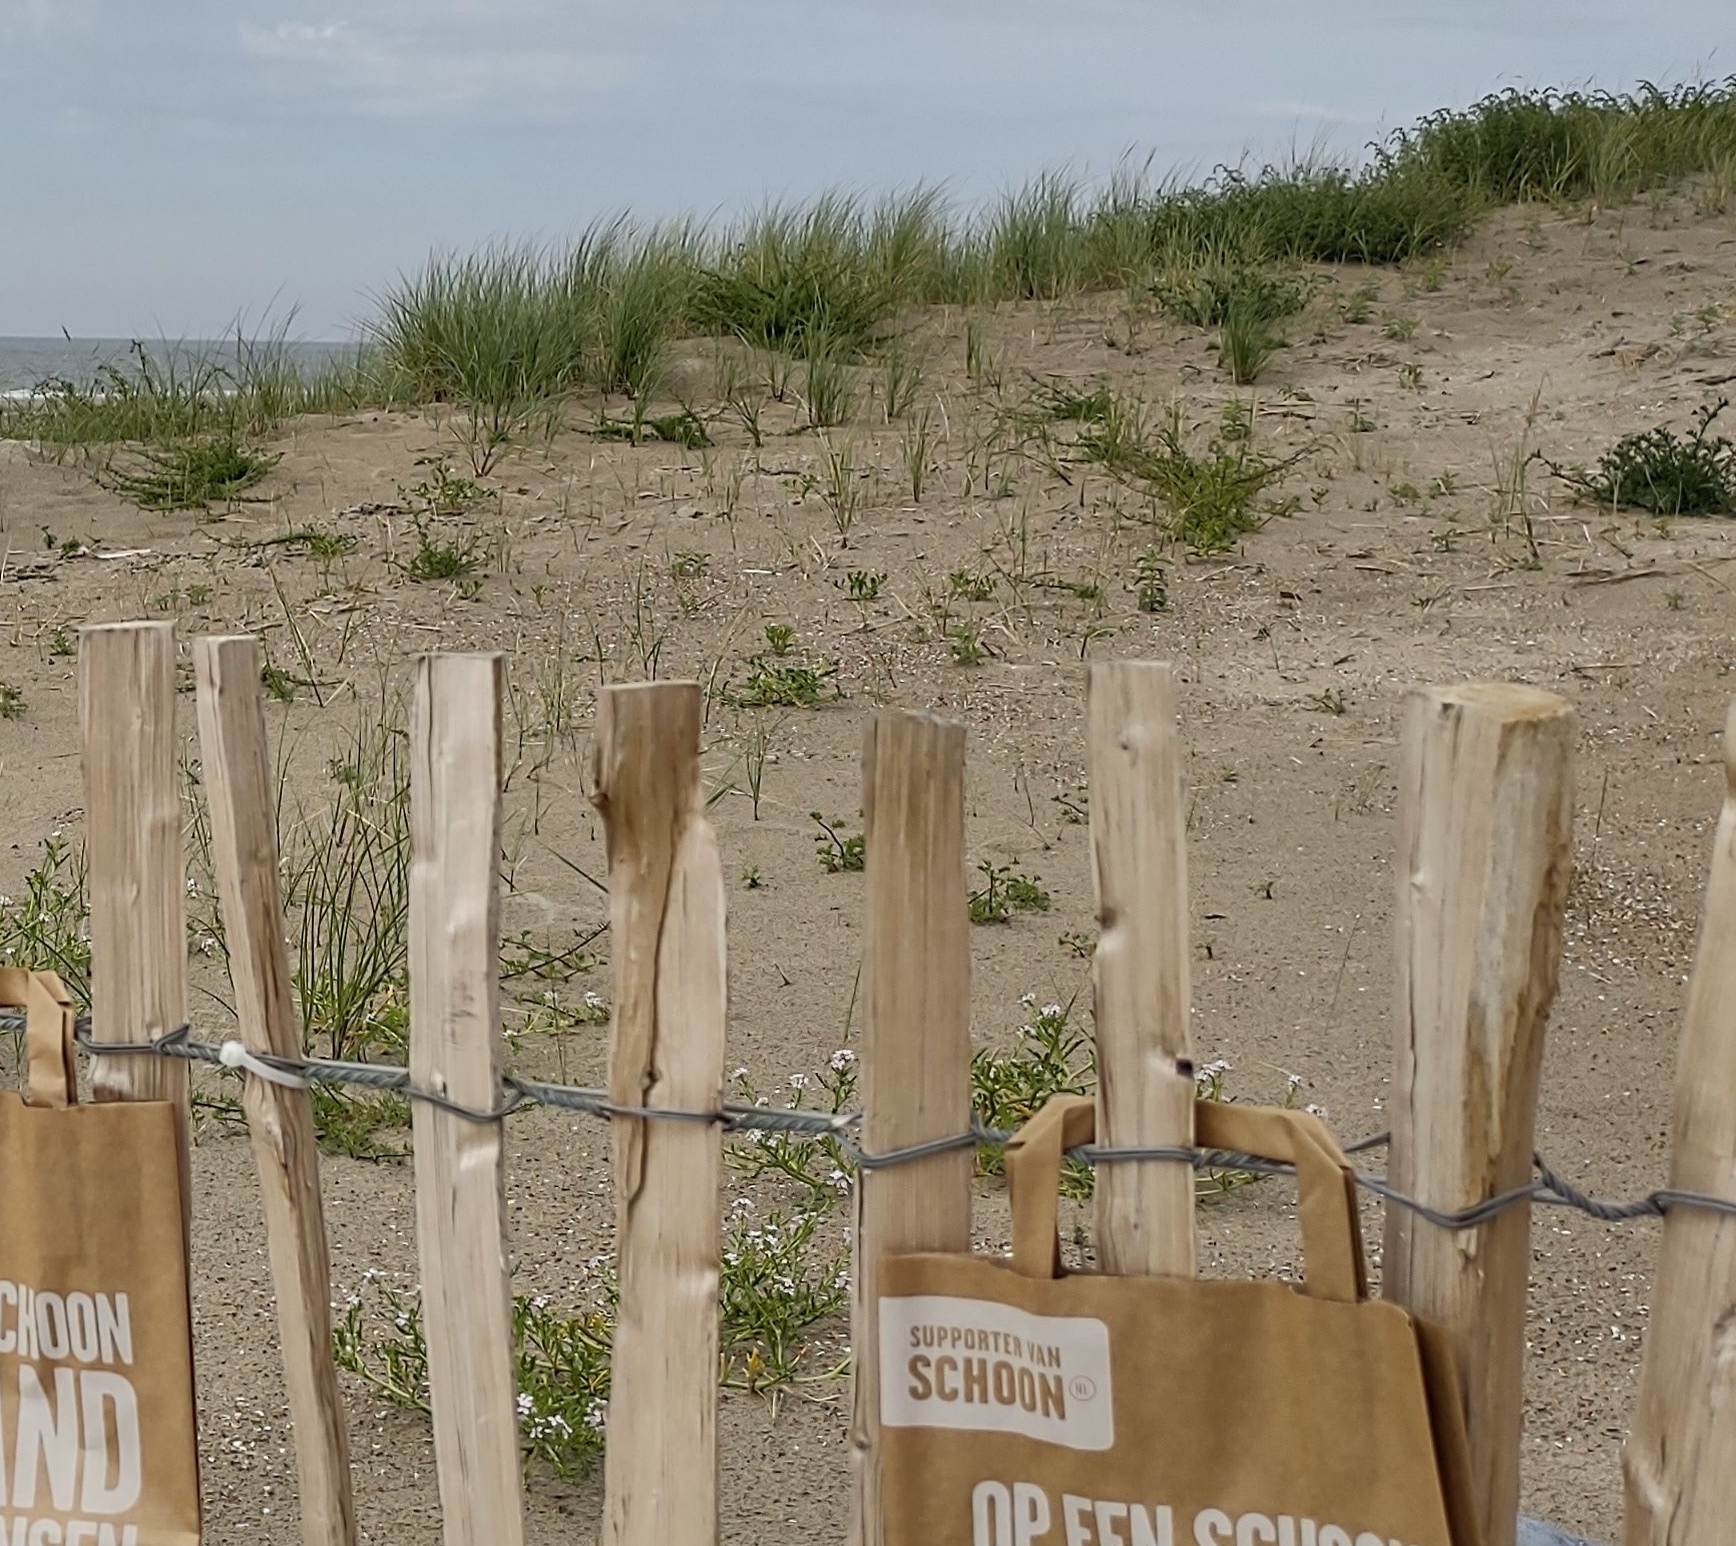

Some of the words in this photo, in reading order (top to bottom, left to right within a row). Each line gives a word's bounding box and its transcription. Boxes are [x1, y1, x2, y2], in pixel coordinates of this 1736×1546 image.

[910, 1325, 1022, 1358] SUPPORTER
[1027, 1341, 1061, 1368] VAN
[908, 1354, 1066, 1420] SCHOON
